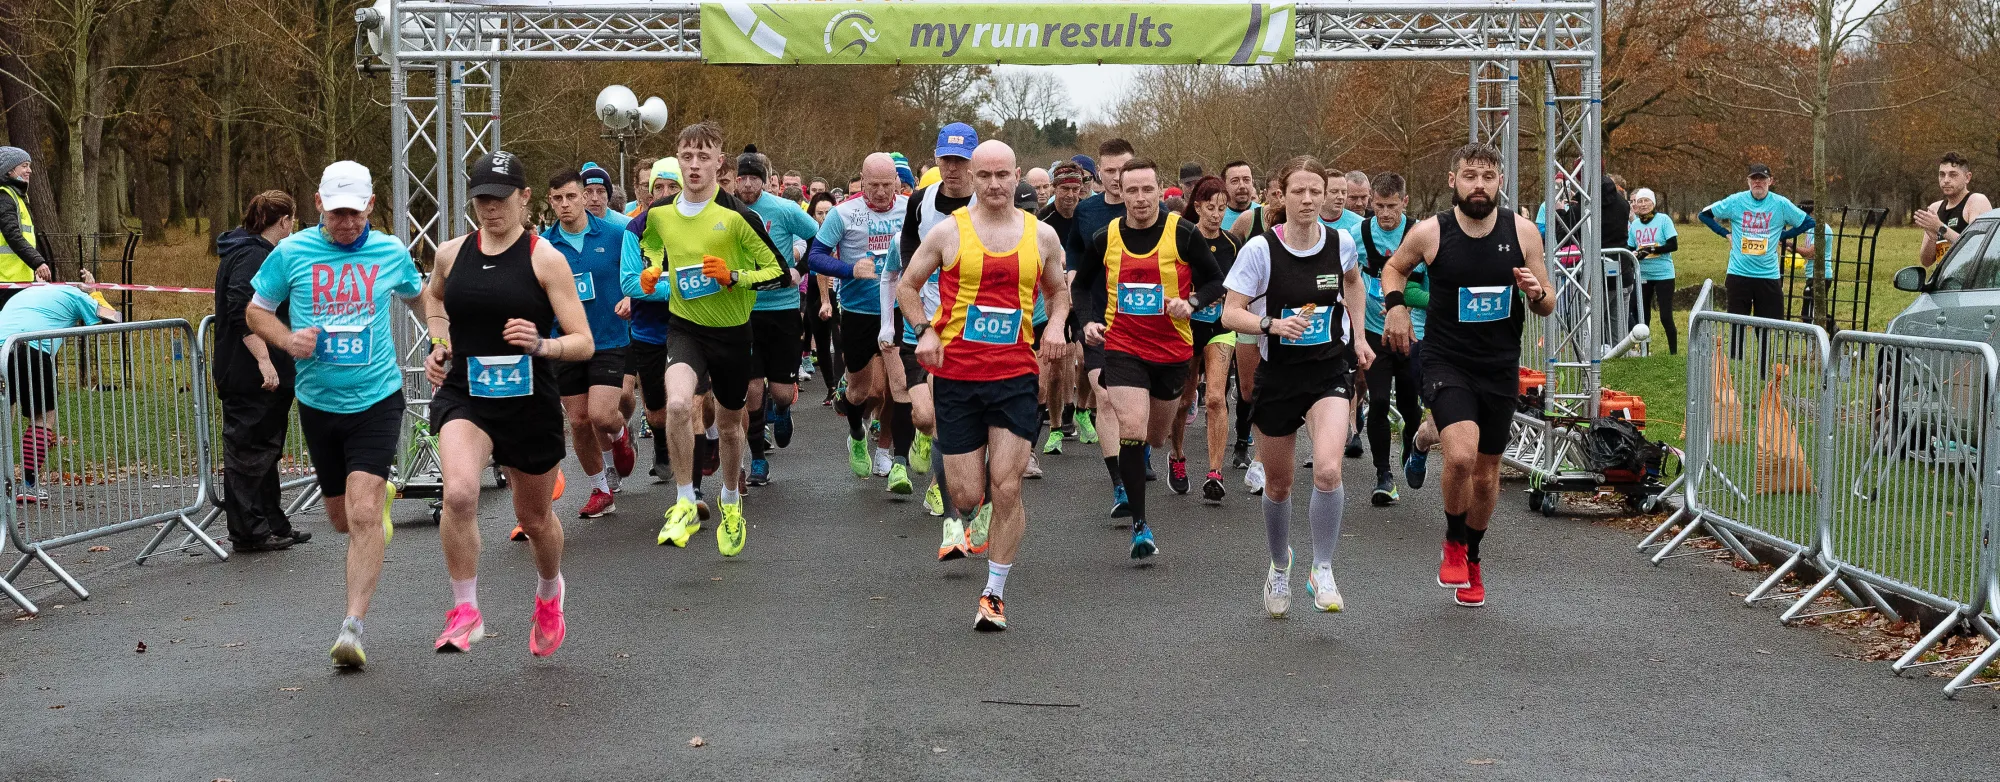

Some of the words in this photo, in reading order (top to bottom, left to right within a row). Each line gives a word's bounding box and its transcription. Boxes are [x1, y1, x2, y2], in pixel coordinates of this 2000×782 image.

[909, 12, 1174, 58] myrunresults
[1741, 210, 1773, 229] RAY
[1635, 227, 1658, 243] RAY
[1742, 242, 1765, 251] 5029
[311, 263, 380, 303] RAY
[678, 274, 712, 292] 669
[312, 302, 376, 316] D'ARCY'S
[1123, 293, 1156, 307] 432
[1466, 297, 1503, 312] 451
[973, 317, 1013, 335] 605
[323, 337, 364, 355] 158
[476, 368, 523, 386] 414
